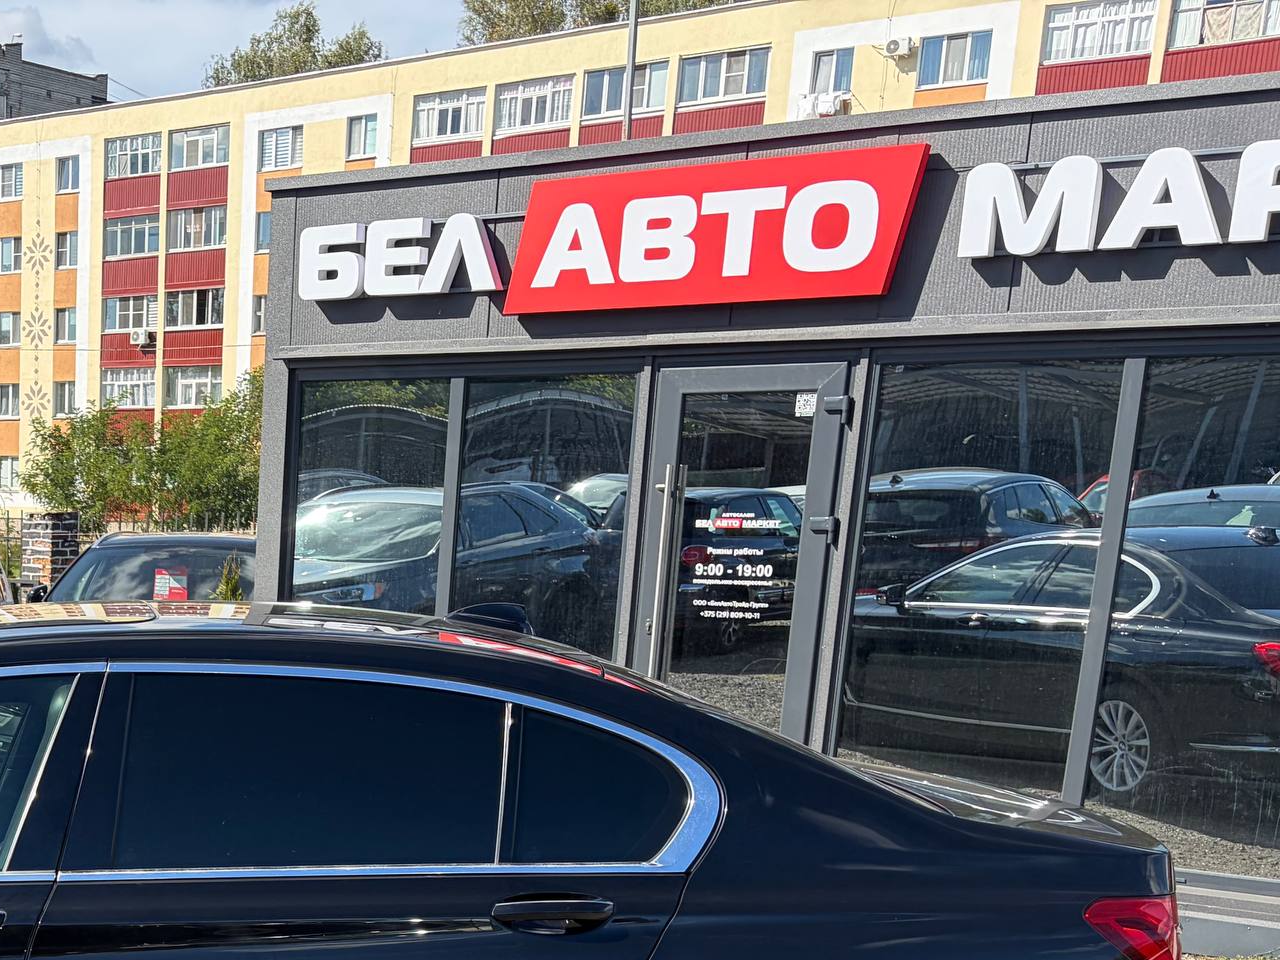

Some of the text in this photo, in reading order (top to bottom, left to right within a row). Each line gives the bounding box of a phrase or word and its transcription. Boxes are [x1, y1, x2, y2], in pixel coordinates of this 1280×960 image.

[298, 213, 504, 301] БЕЛ
[530, 179, 880, 288] АВТО
[707, 547, 764, 556] Режим работы
[695, 563, 724, 576] 9:00
[736, 564, 773, 577] 19:00
[699, 610, 716, 618] +375
[716, 610, 729, 619] (29)
